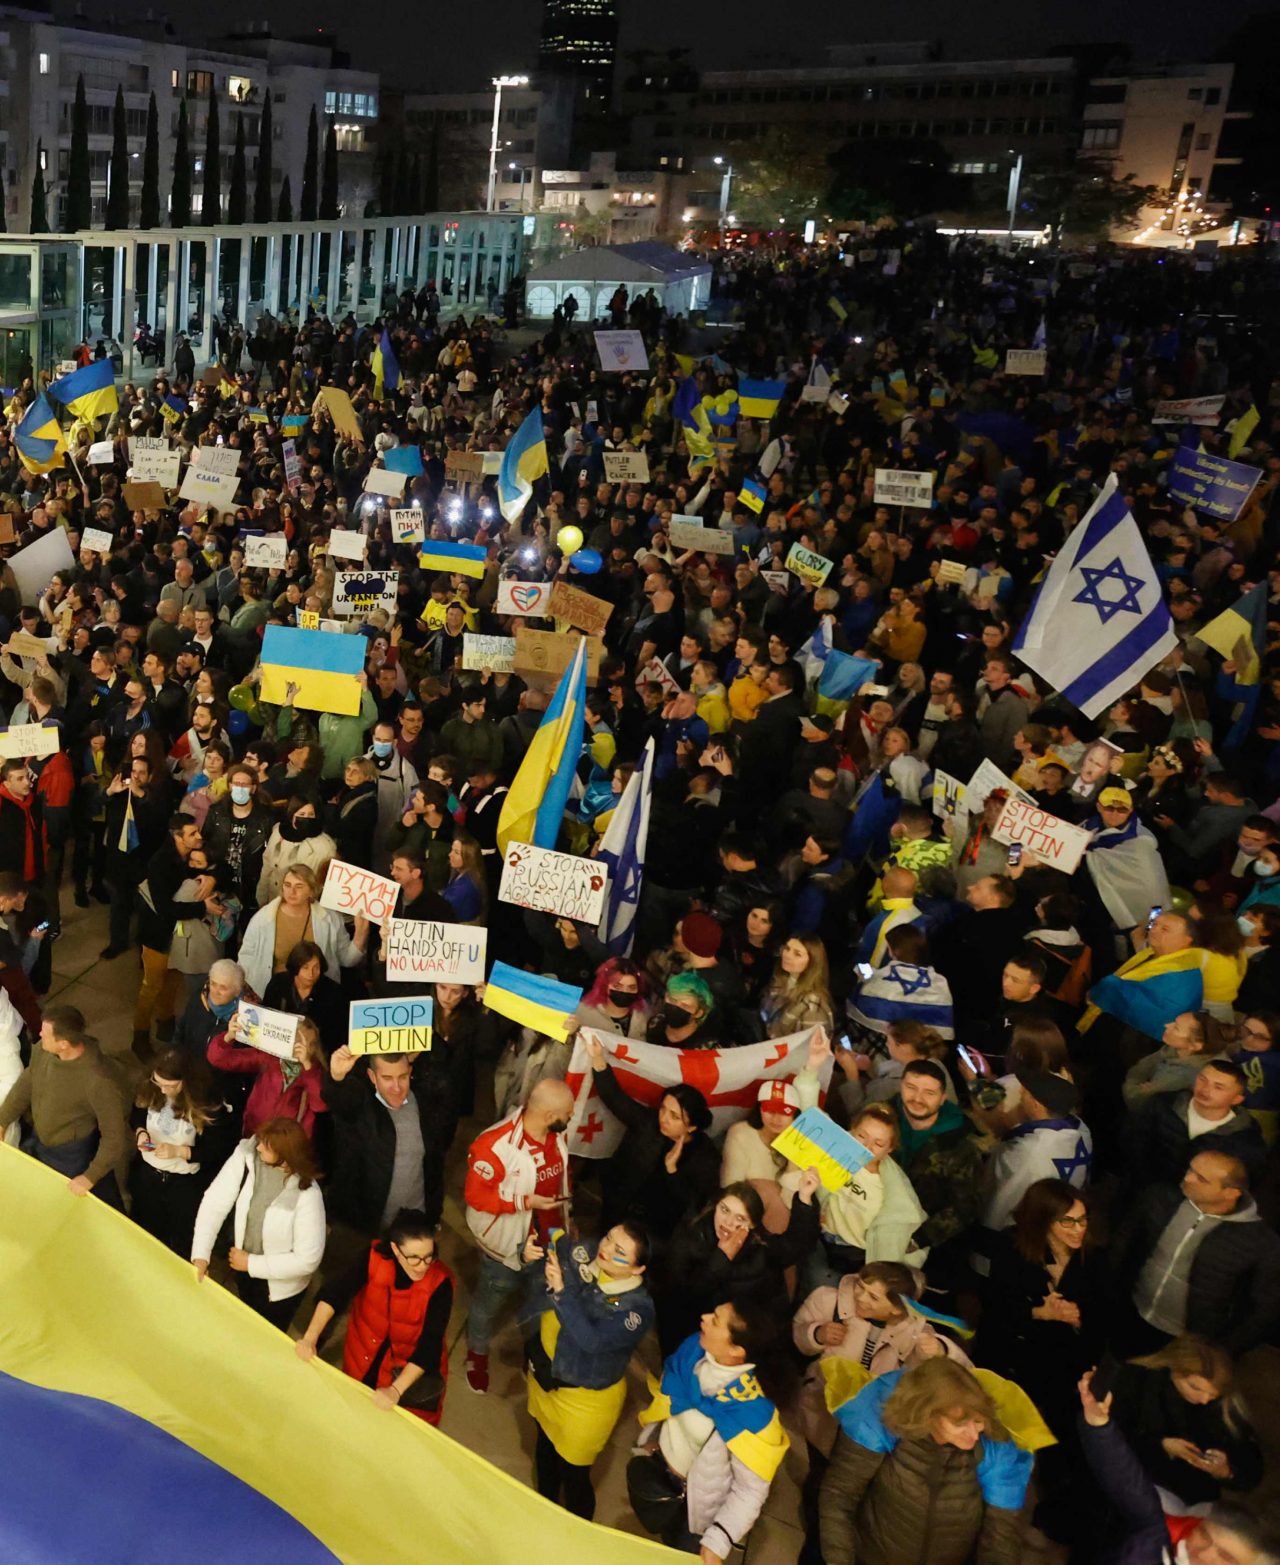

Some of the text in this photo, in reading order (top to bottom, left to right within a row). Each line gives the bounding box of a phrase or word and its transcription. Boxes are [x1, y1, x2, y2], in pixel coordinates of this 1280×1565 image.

[396, 511, 422, 521] ПУТИН
[795, 550, 827, 571] GLORY
[339, 573, 374, 584] STOP
[382, 591, 396, 601] ON
[1006, 800, 1059, 832] STOP
[998, 815, 1065, 858] PUTIN
[539, 851, 585, 874] STOP
[329, 864, 396, 903] ПУТИН
[512, 863, 593, 901] RUSSIAN
[502, 883, 593, 919] AGRESSION
[391, 920, 446, 942] PUTIN
[389, 937, 480, 962] HANDS OFF U
[389, 957, 407, 972] NO
[411, 957, 446, 972] WAR
[362, 1004, 426, 1029] STOP
[262, 1028, 292, 1044] UKRAINE
[363, 1027, 429, 1053] PUTIN
[784, 1117, 824, 1152] NO
